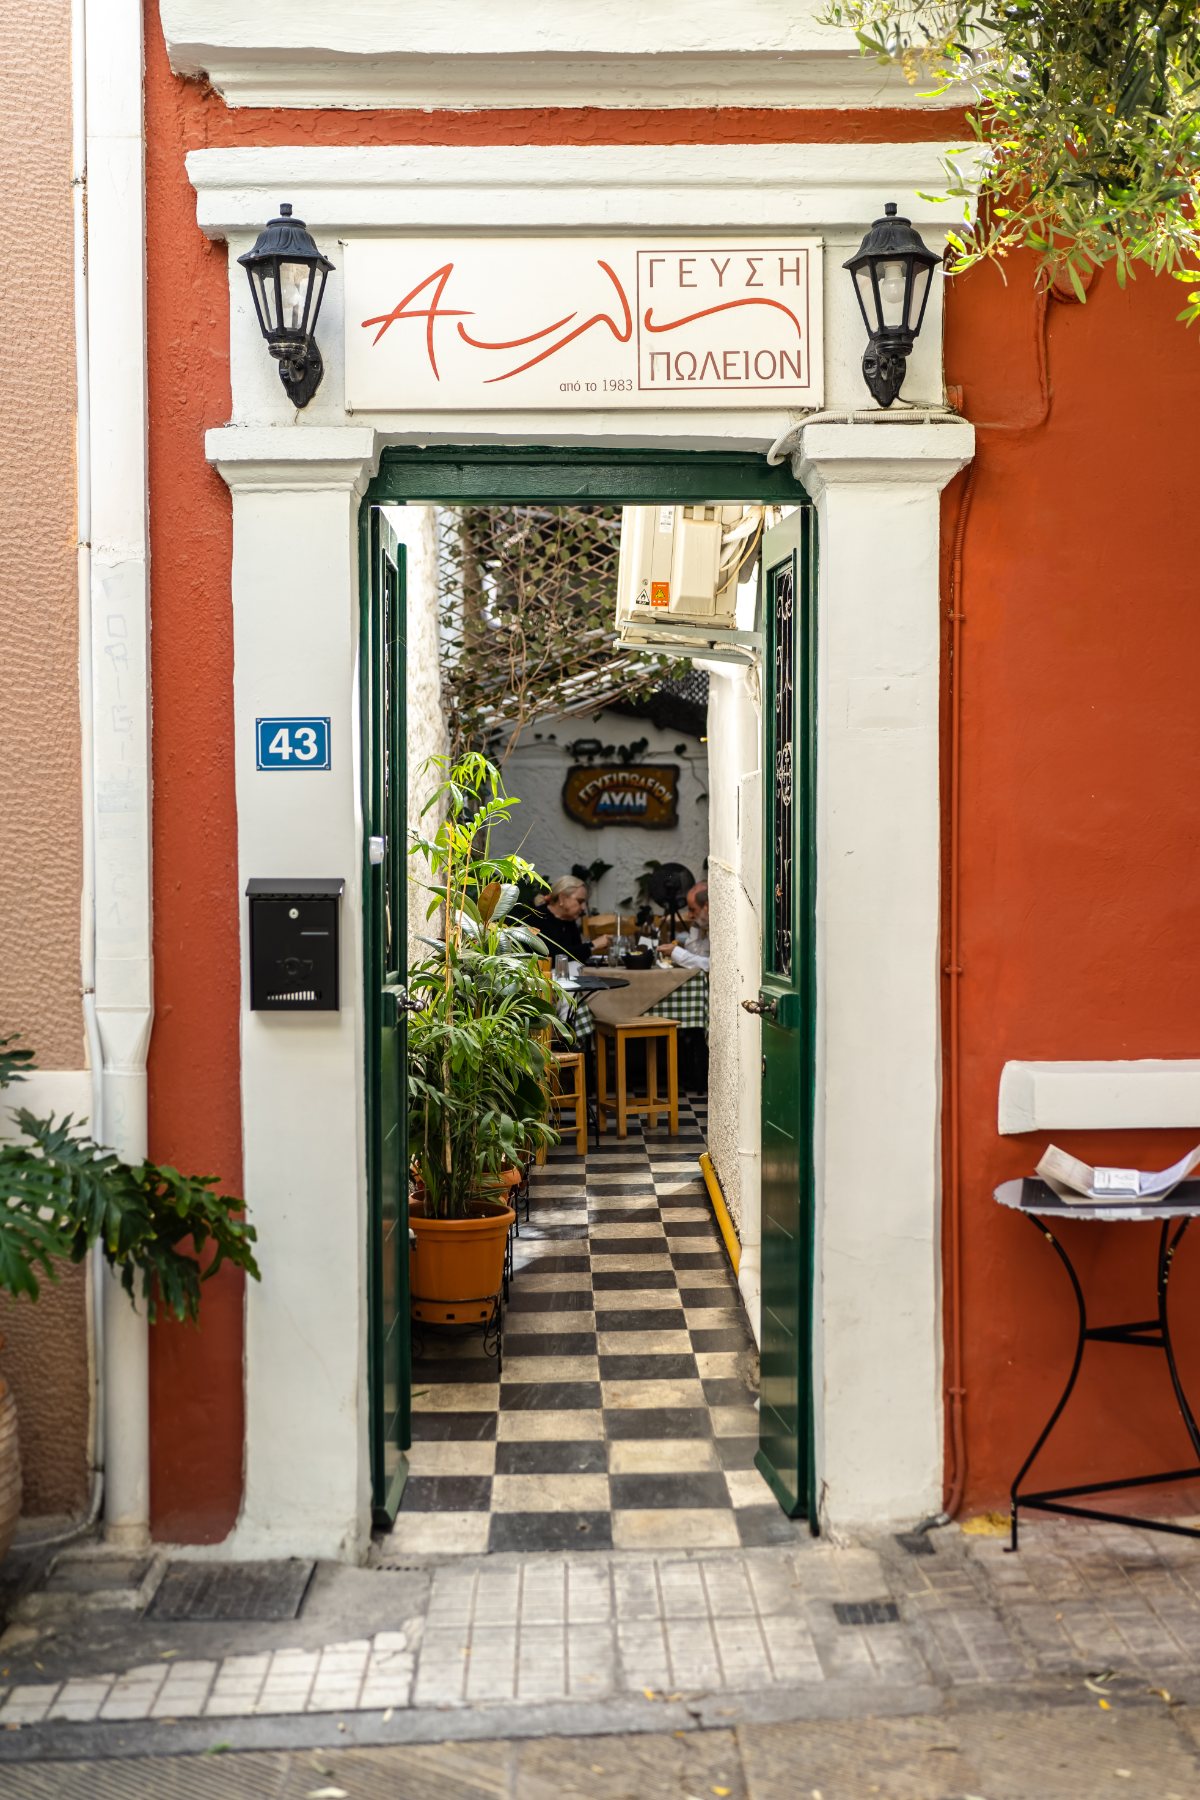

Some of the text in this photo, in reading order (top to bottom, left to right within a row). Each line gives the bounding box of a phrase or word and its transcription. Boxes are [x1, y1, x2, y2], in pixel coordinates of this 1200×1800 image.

[649, 256, 802, 288] ΓΕΥΣΗ
[649, 349, 802, 382] ΠΩΛΕΙΟΝ
[559, 378, 633, 392] από το 1983
[268, 727, 318, 760] 43
[598, 791, 648, 810] ΑΥΛΗ
